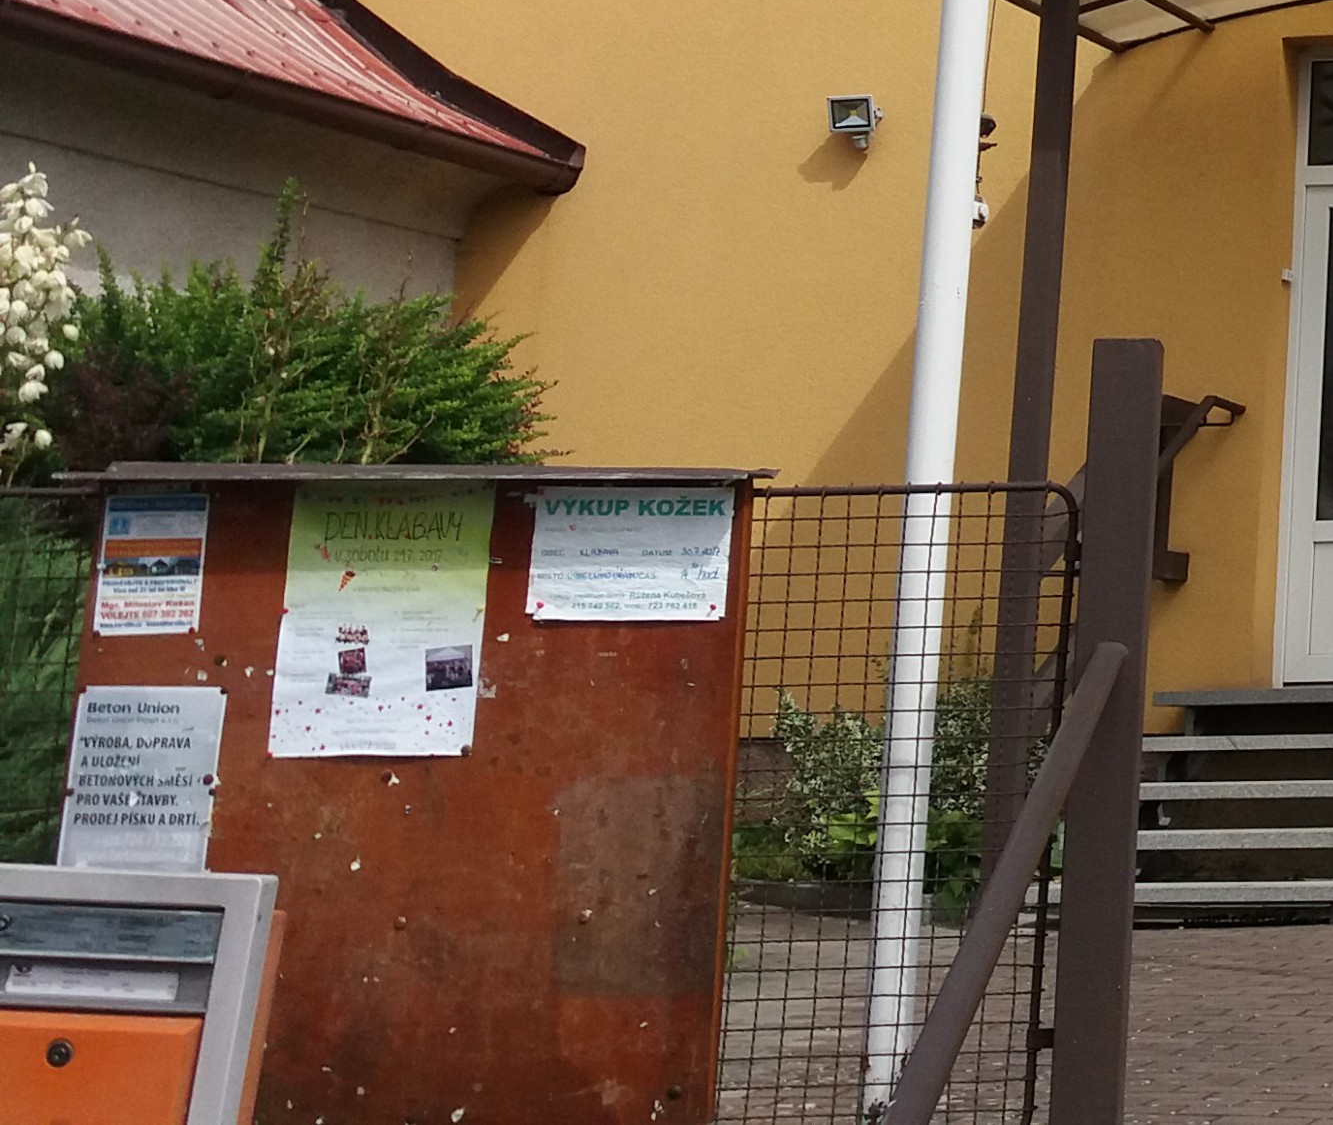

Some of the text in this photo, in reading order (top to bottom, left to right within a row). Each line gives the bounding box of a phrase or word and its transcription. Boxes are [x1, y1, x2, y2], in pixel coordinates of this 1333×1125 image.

[545, 495, 726, 516] VÝKUP KOŽEK
[324, 512, 464, 541] DEN KLABAVY
[87, 701, 180, 714] Beton Union
[137, 737, 191, 749] DOPRAVA
[81, 753, 141, 767] A ULOŽENÍ
[79, 772, 154, 787] BETONOVÝCH
[76, 794, 99, 806] PRO
[74, 811, 200, 825] PRODEJ PÍSKU A DRTÍ.
